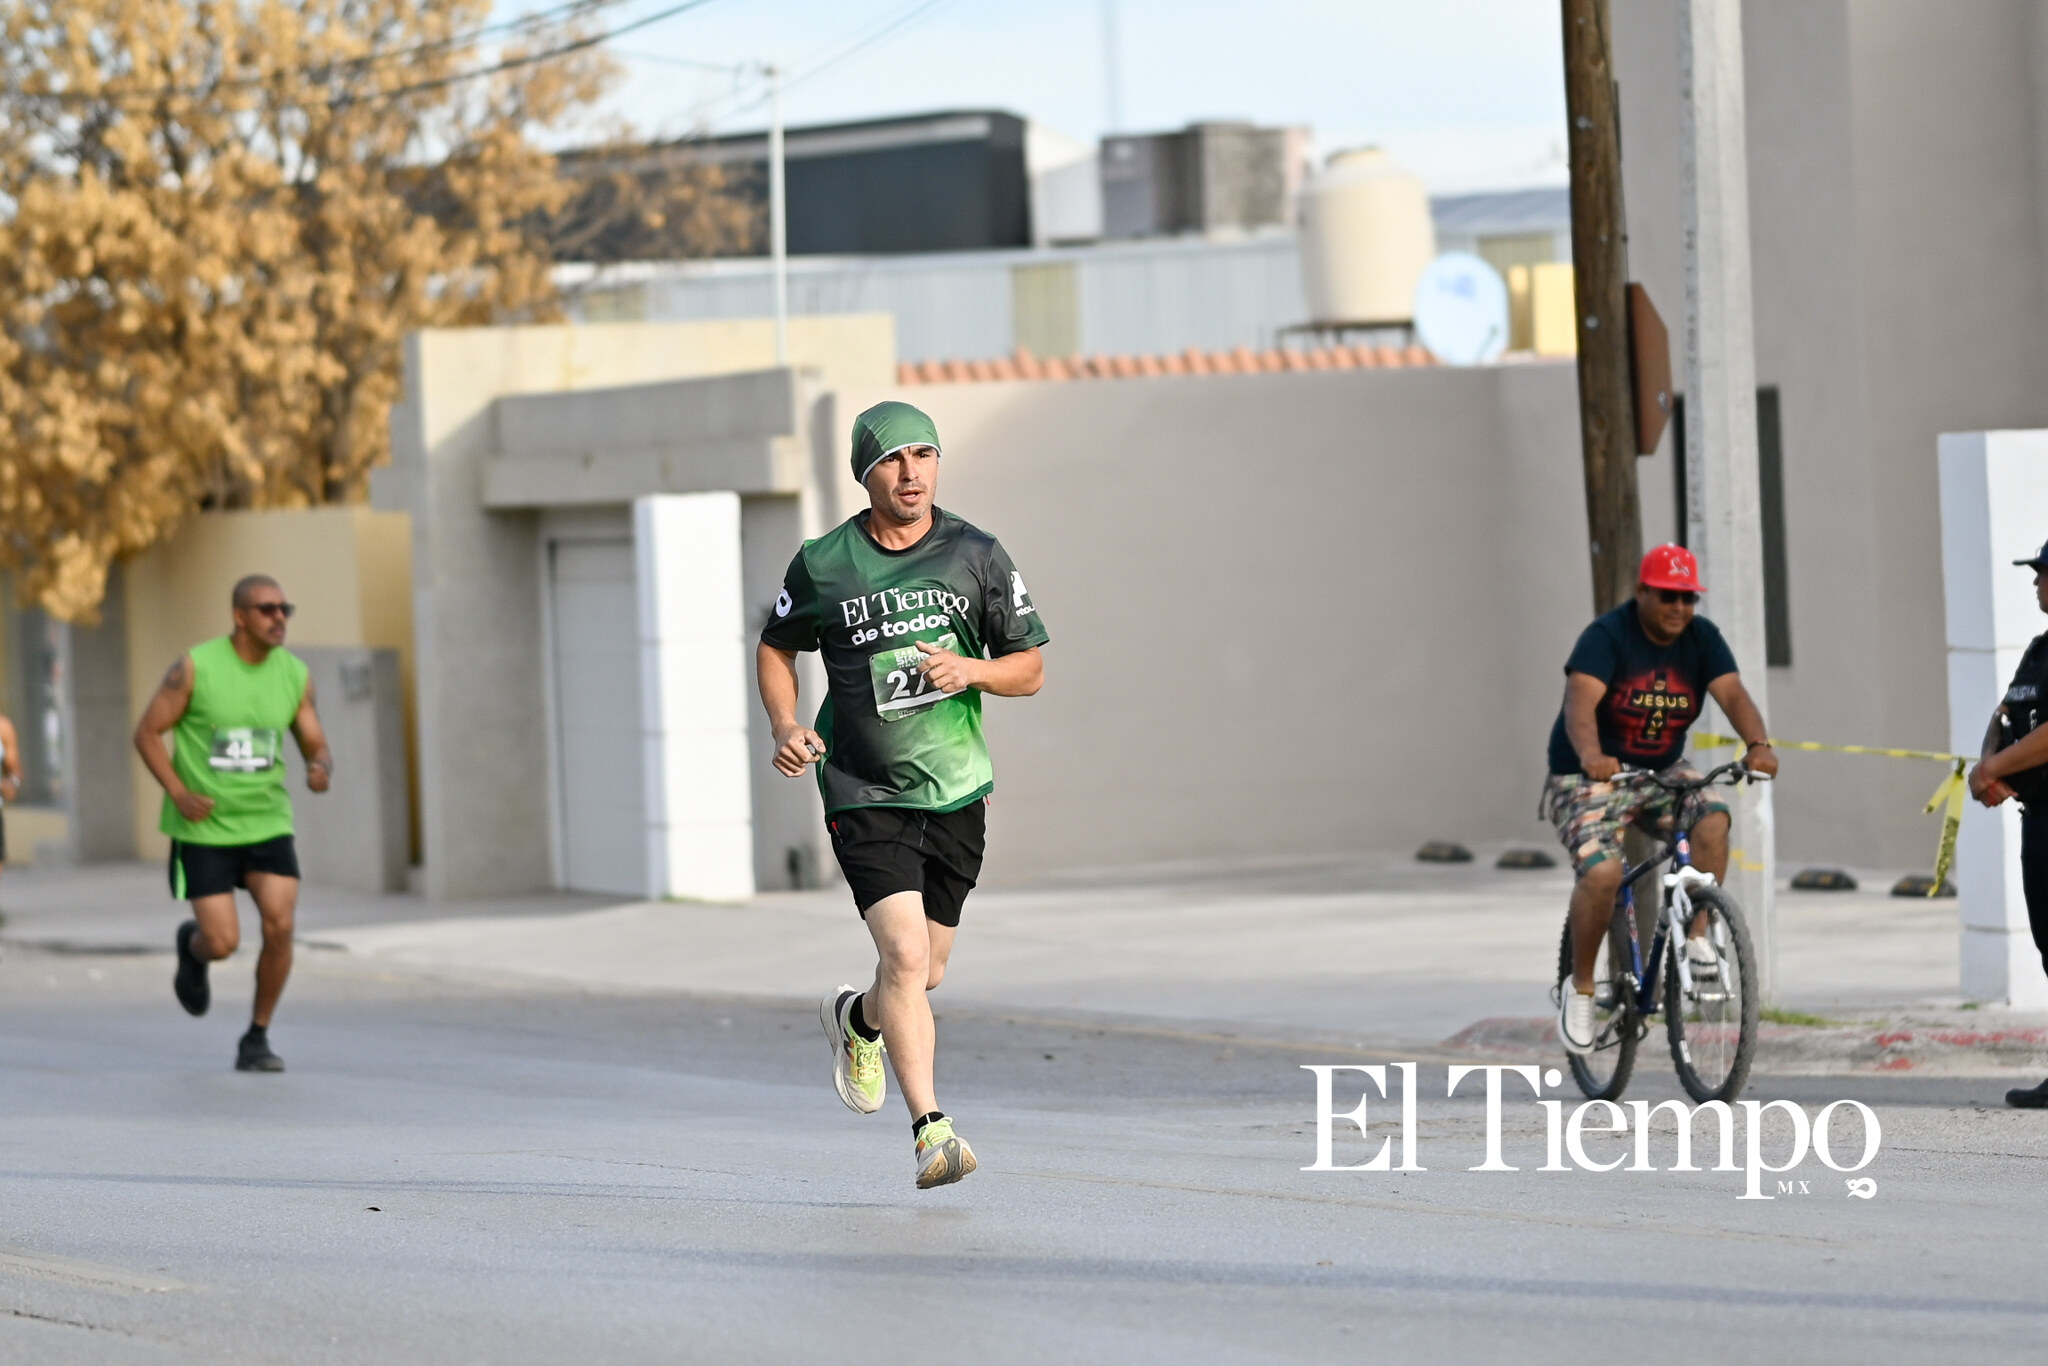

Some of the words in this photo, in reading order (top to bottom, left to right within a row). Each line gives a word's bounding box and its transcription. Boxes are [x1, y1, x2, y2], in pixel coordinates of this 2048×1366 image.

[840, 595, 872, 628] El
[871, 587, 970, 620] Tiempo
[851, 628, 879, 646] de
[881, 613, 951, 637] todos
[1633, 693, 1689, 708] JESUS
